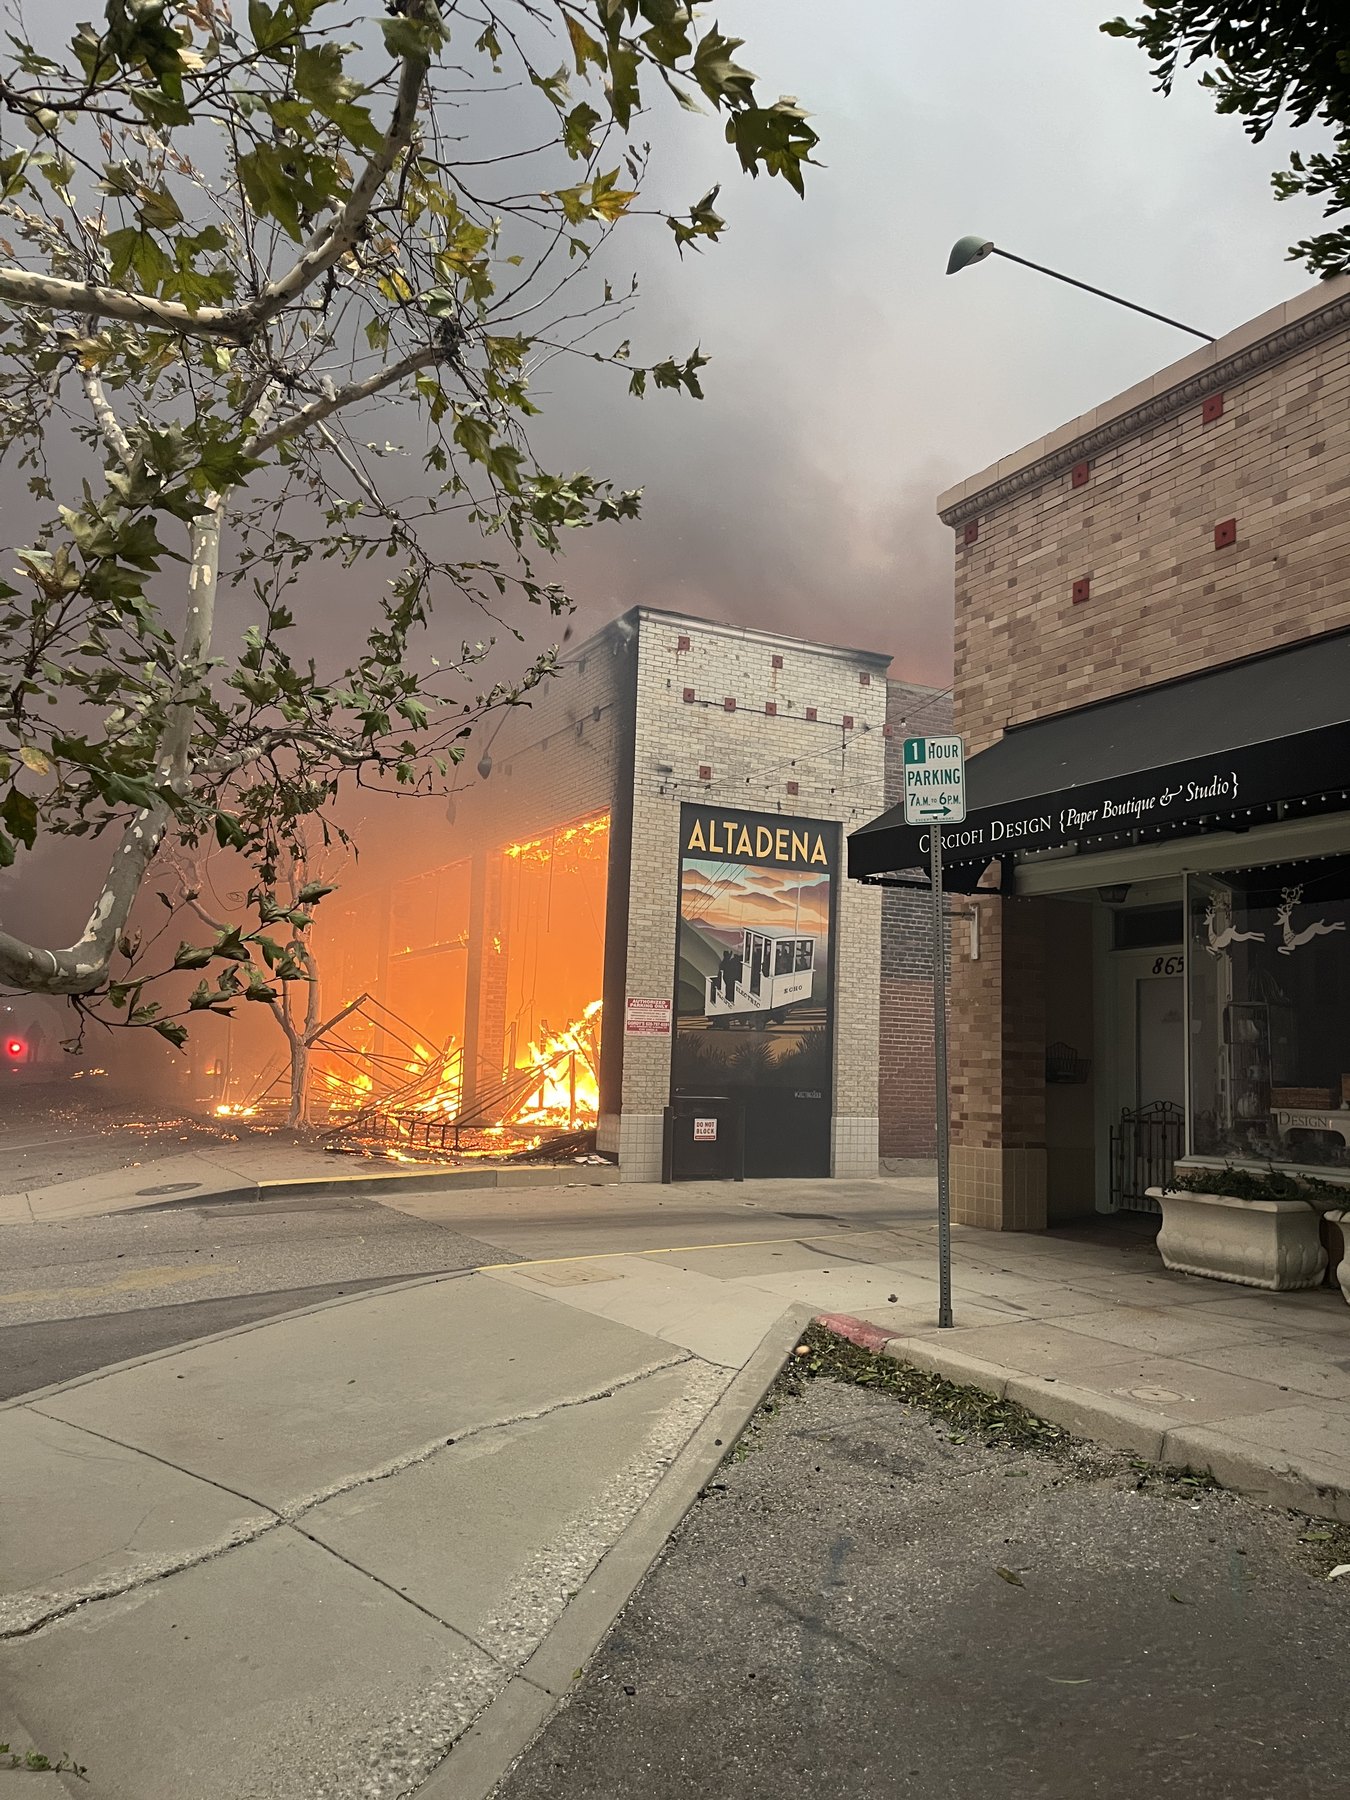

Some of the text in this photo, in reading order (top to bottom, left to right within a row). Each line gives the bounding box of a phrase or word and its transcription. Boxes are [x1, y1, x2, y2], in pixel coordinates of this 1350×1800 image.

[911, 742, 959, 761] 1 HOUR
[907, 768, 961, 786] PARKING
[919, 829, 984, 853] CRCIOFI
[990, 815, 1052, 841] DESIGN
[1101, 796, 1156, 819] Boutique
[1159, 785, 1183, 807] &
[687, 818, 828, 865] ALTADENA
[1152, 956, 1184, 975] 865
[735, 986, 761, 1009] ELECTRIC
[783, 984, 803, 995] ECHO
[1279, 1111, 1328, 1128] DESIGN
